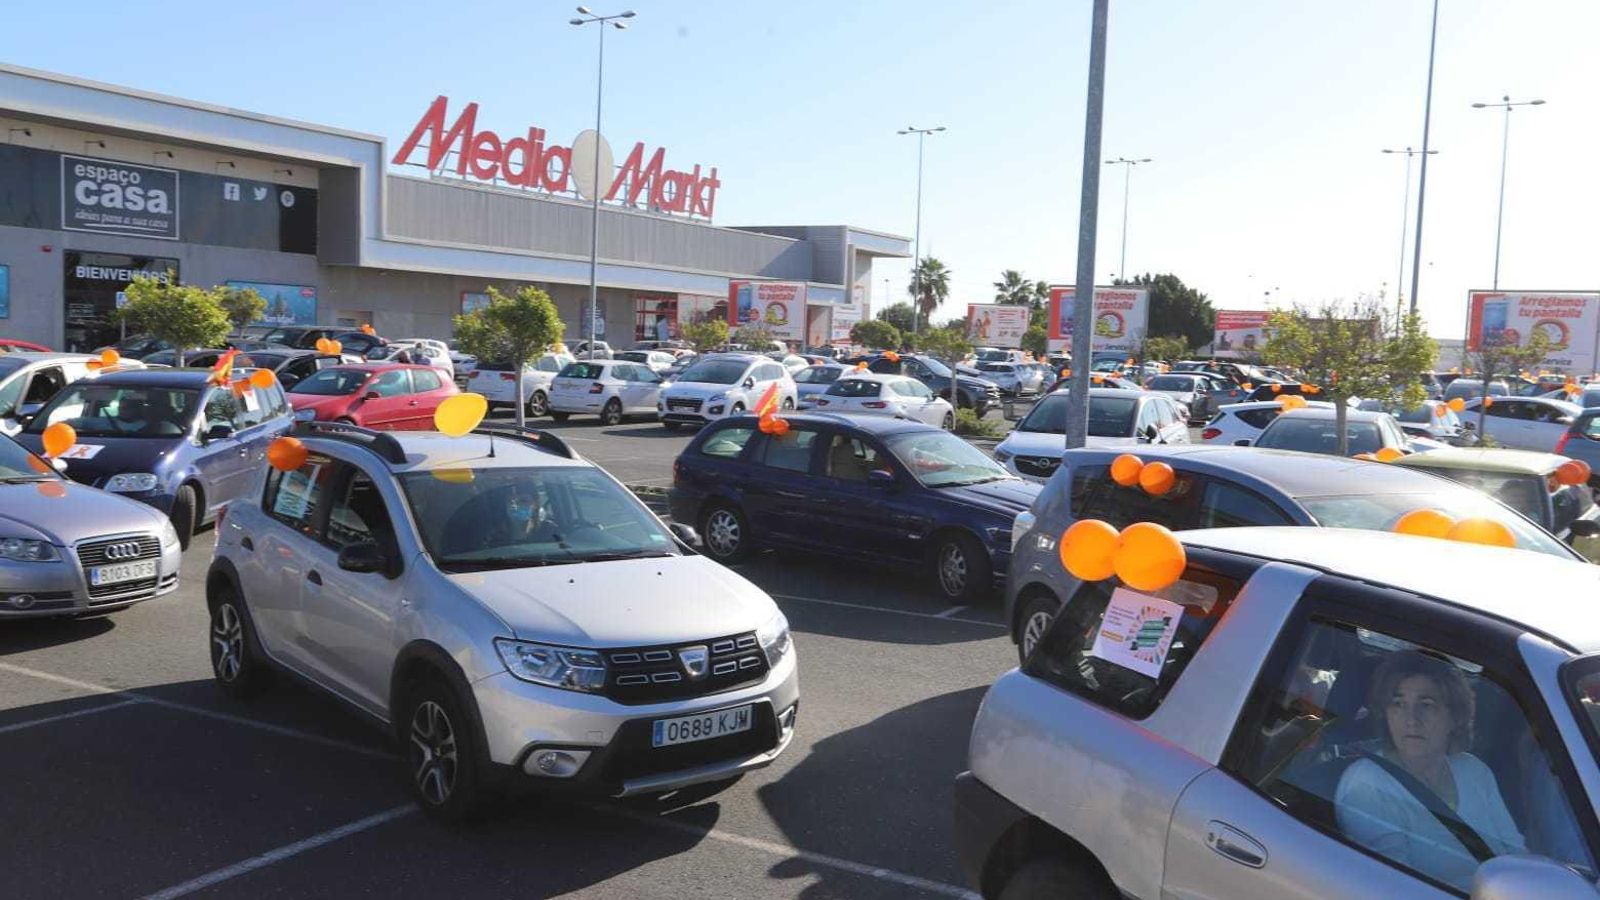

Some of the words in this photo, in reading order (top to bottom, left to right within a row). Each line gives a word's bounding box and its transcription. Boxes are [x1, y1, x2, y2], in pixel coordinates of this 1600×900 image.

[391, 95, 573, 192] Media
[602, 141, 721, 218] Markt
[74, 164, 141, 186] espaço
[75, 180, 168, 214] casa
[668, 717, 713, 741] 0689
[719, 709, 749, 733] KJM
